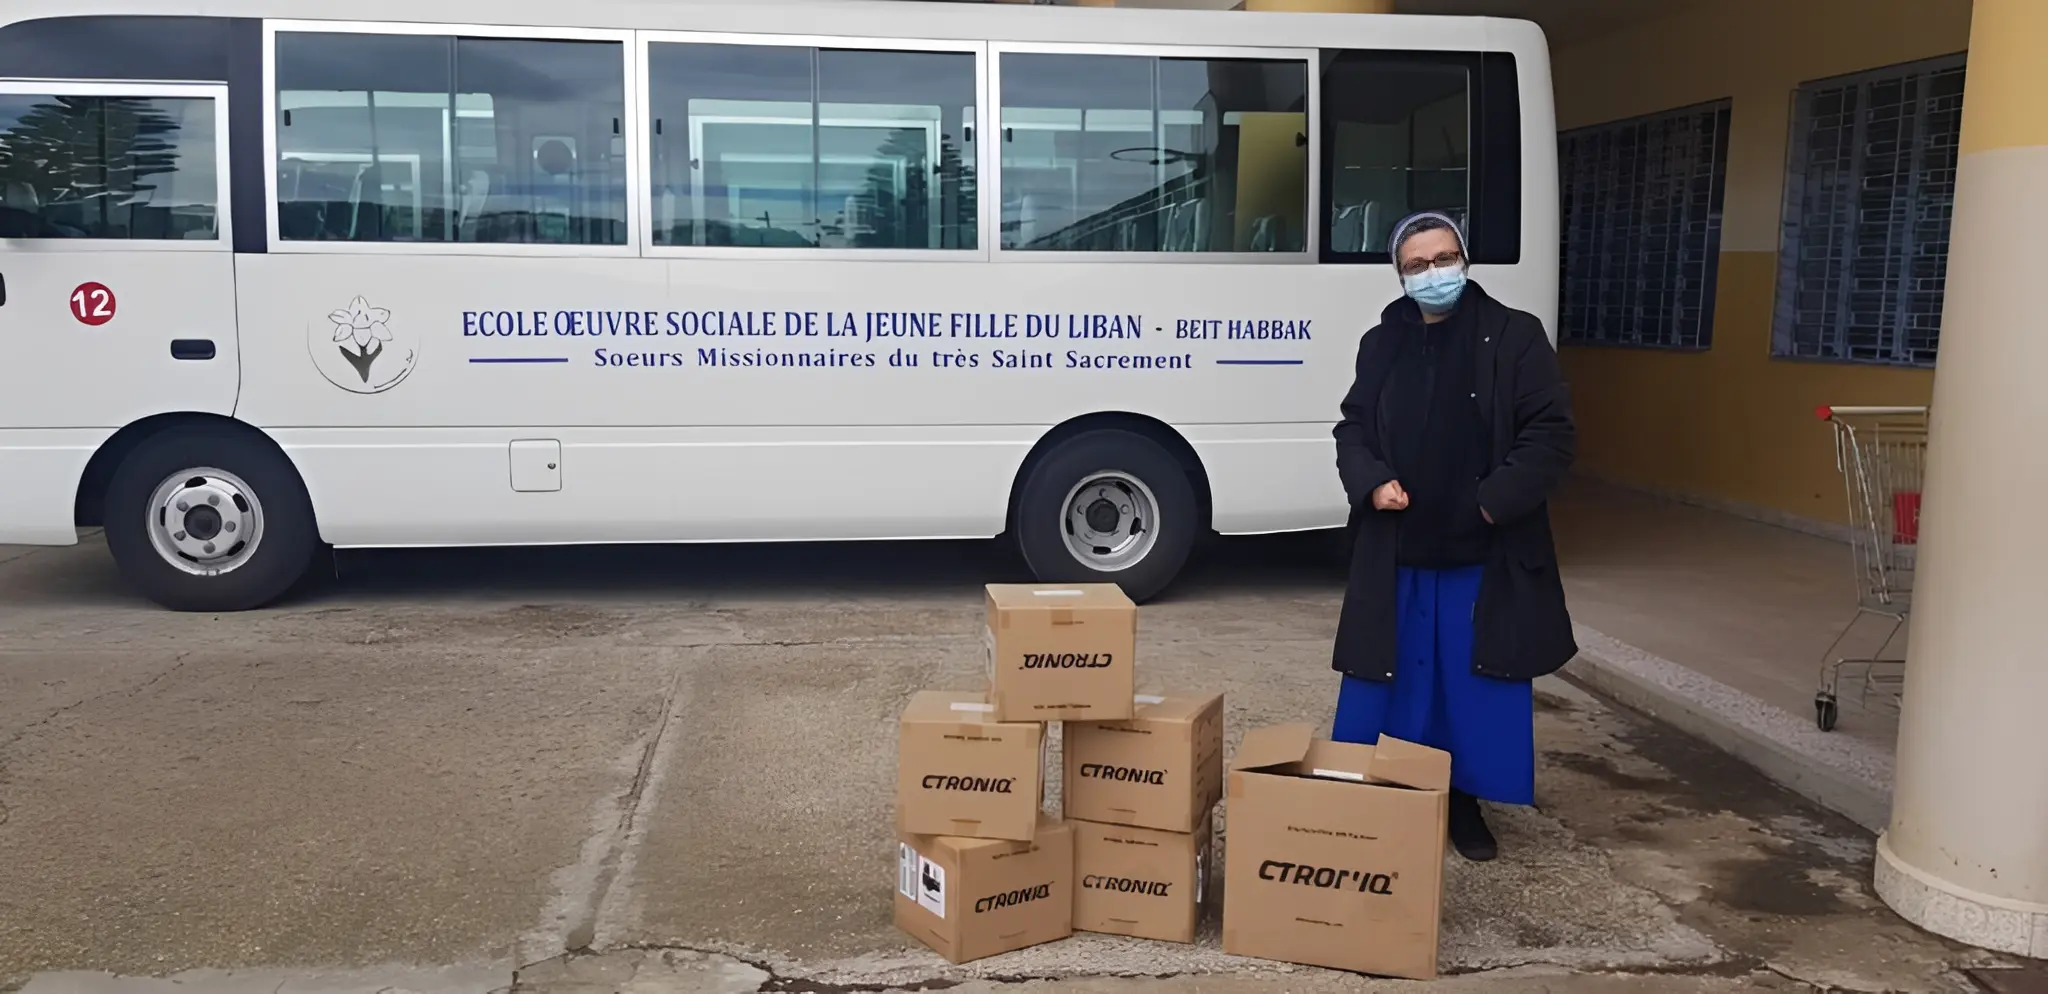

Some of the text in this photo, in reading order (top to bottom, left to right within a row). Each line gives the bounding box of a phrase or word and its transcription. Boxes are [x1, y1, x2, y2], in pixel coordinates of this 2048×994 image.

[72, 289, 112, 318] 12
[462, 310, 548, 337] ECOLE
[666, 311, 777, 337] SOCIALE
[784, 311, 819, 337] DE
[826, 311, 858, 338] LA
[865, 311, 942, 343] JEUNE
[950, 312, 1018, 338] FILLE
[1026, 313, 1060, 339] DU
[1068, 314, 1142, 340] LIBAN
[1175, 319, 1223, 340] BEIT
[1227, 319, 1312, 341] HABBAK
[594, 347, 1193, 369] Soeurs Missionnaires du très Saint Sacrement
[1022, 653, 1113, 669] CTRONIQ
[922, 774, 1013, 794] CTRONIQ
[1080, 763, 1164, 785] CTRONIQ
[1082, 874, 1168, 897] CTRONIQ
